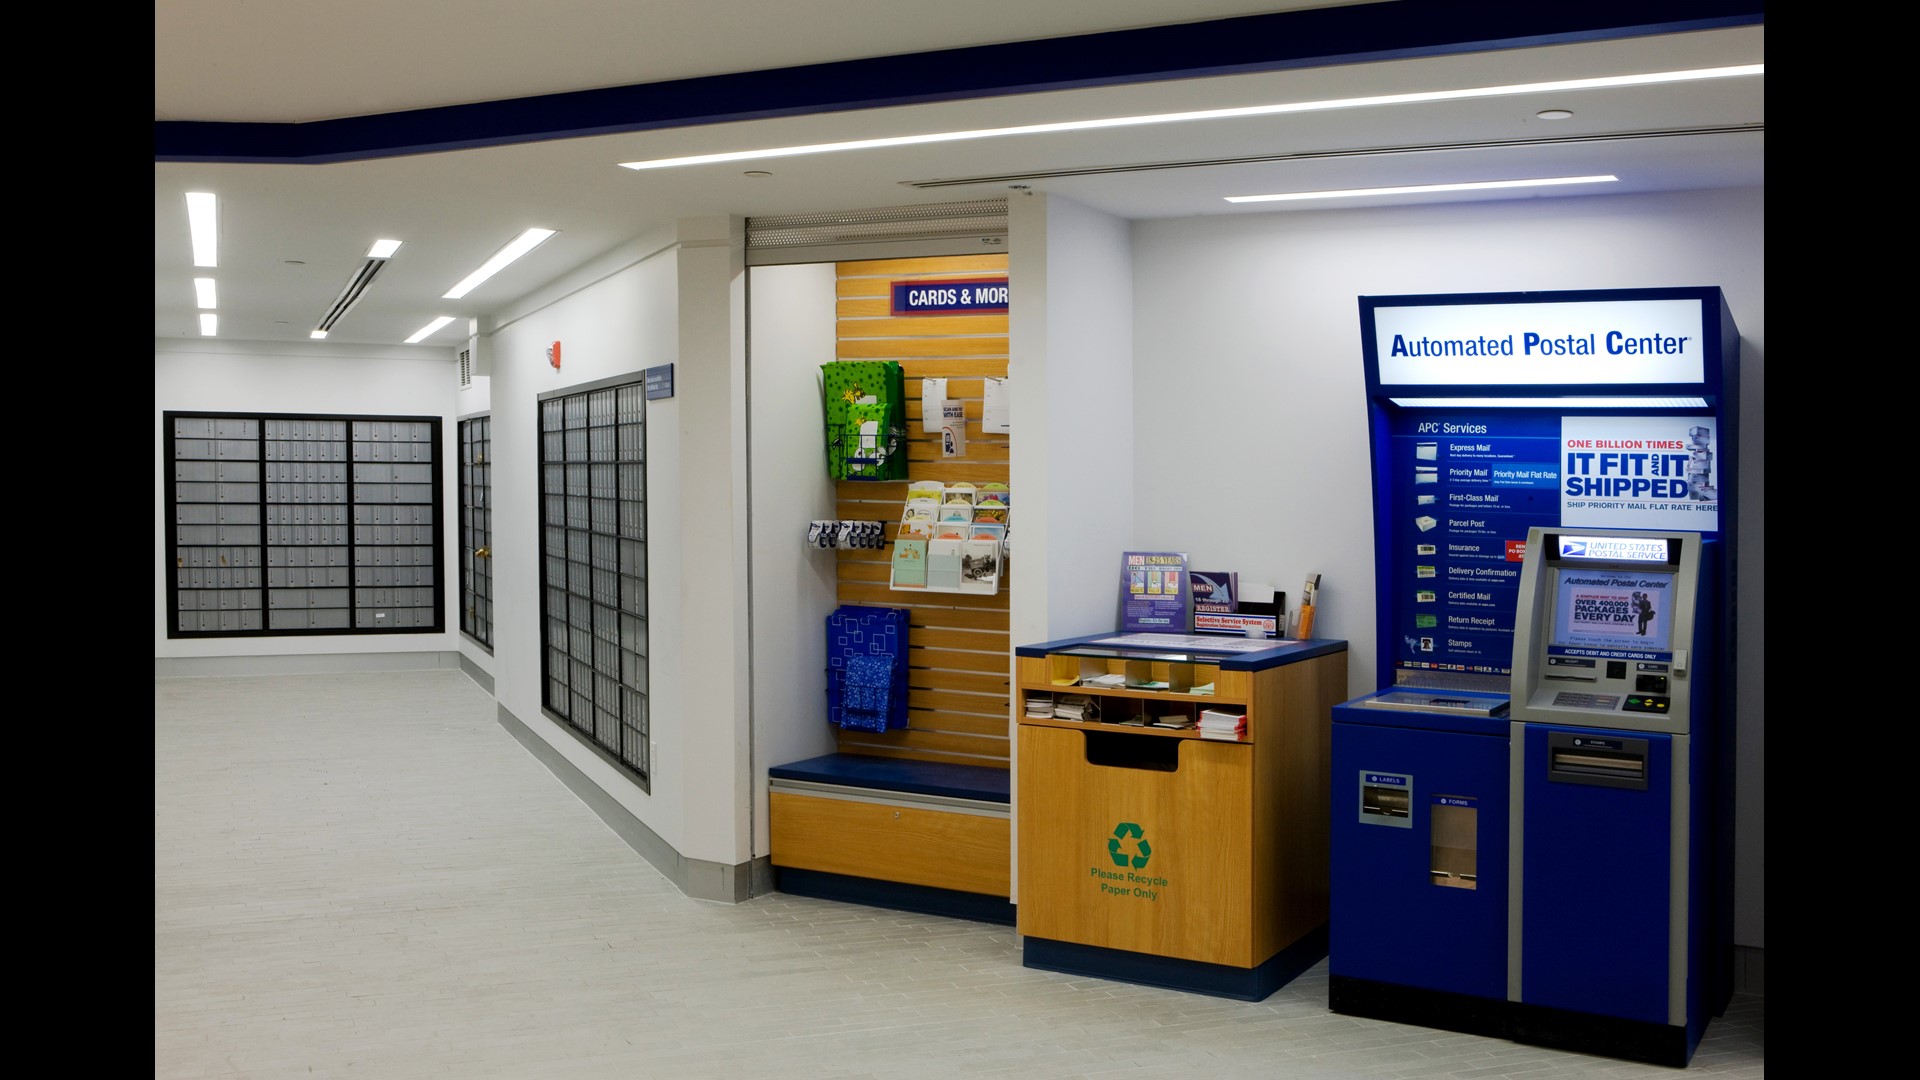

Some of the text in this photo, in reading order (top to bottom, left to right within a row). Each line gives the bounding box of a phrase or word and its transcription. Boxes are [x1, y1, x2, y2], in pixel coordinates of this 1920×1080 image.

[909, 288, 1008, 306] CARDS & MOR
[1390, 331, 1688, 358] Automated Postal Center
[1418, 422, 1487, 434] APC Services
[1450, 444, 1475, 453] Express
[1567, 440, 1684, 450] ONE BILLION TIMES
[1568, 453, 1689, 476] IT FIT AND IT
[1450, 469, 1488, 478] Priority Mail
[1494, 471, 1515, 480] Priority
[1566, 477, 1688, 498] SHIPPED
[1449, 494, 1483, 502] First-Class
[1449, 519, 1469, 527] Parcel
[1449, 544, 1480, 552] Insurance
[1590, 542, 1663, 552] UNITED STATES
[1588, 550, 1666, 560] POSTAL SERVICE
[1128, 556, 1145, 565] MEN
[1448, 567, 1517, 577] Delivery Confirmation
[1565, 577, 1668, 588] Automated Postal Center
[1448, 592, 1475, 600] Certified
[1575, 606, 1628, 614] PACKAGES
[1448, 616, 1495, 626] Return Receipt
[1574, 613, 1636, 622] EVERY DAY
[1448, 639, 1472, 648] Stamps
[1090, 867, 1168, 886] Please Recycle
[1101, 883, 1157, 901] Paper Only
